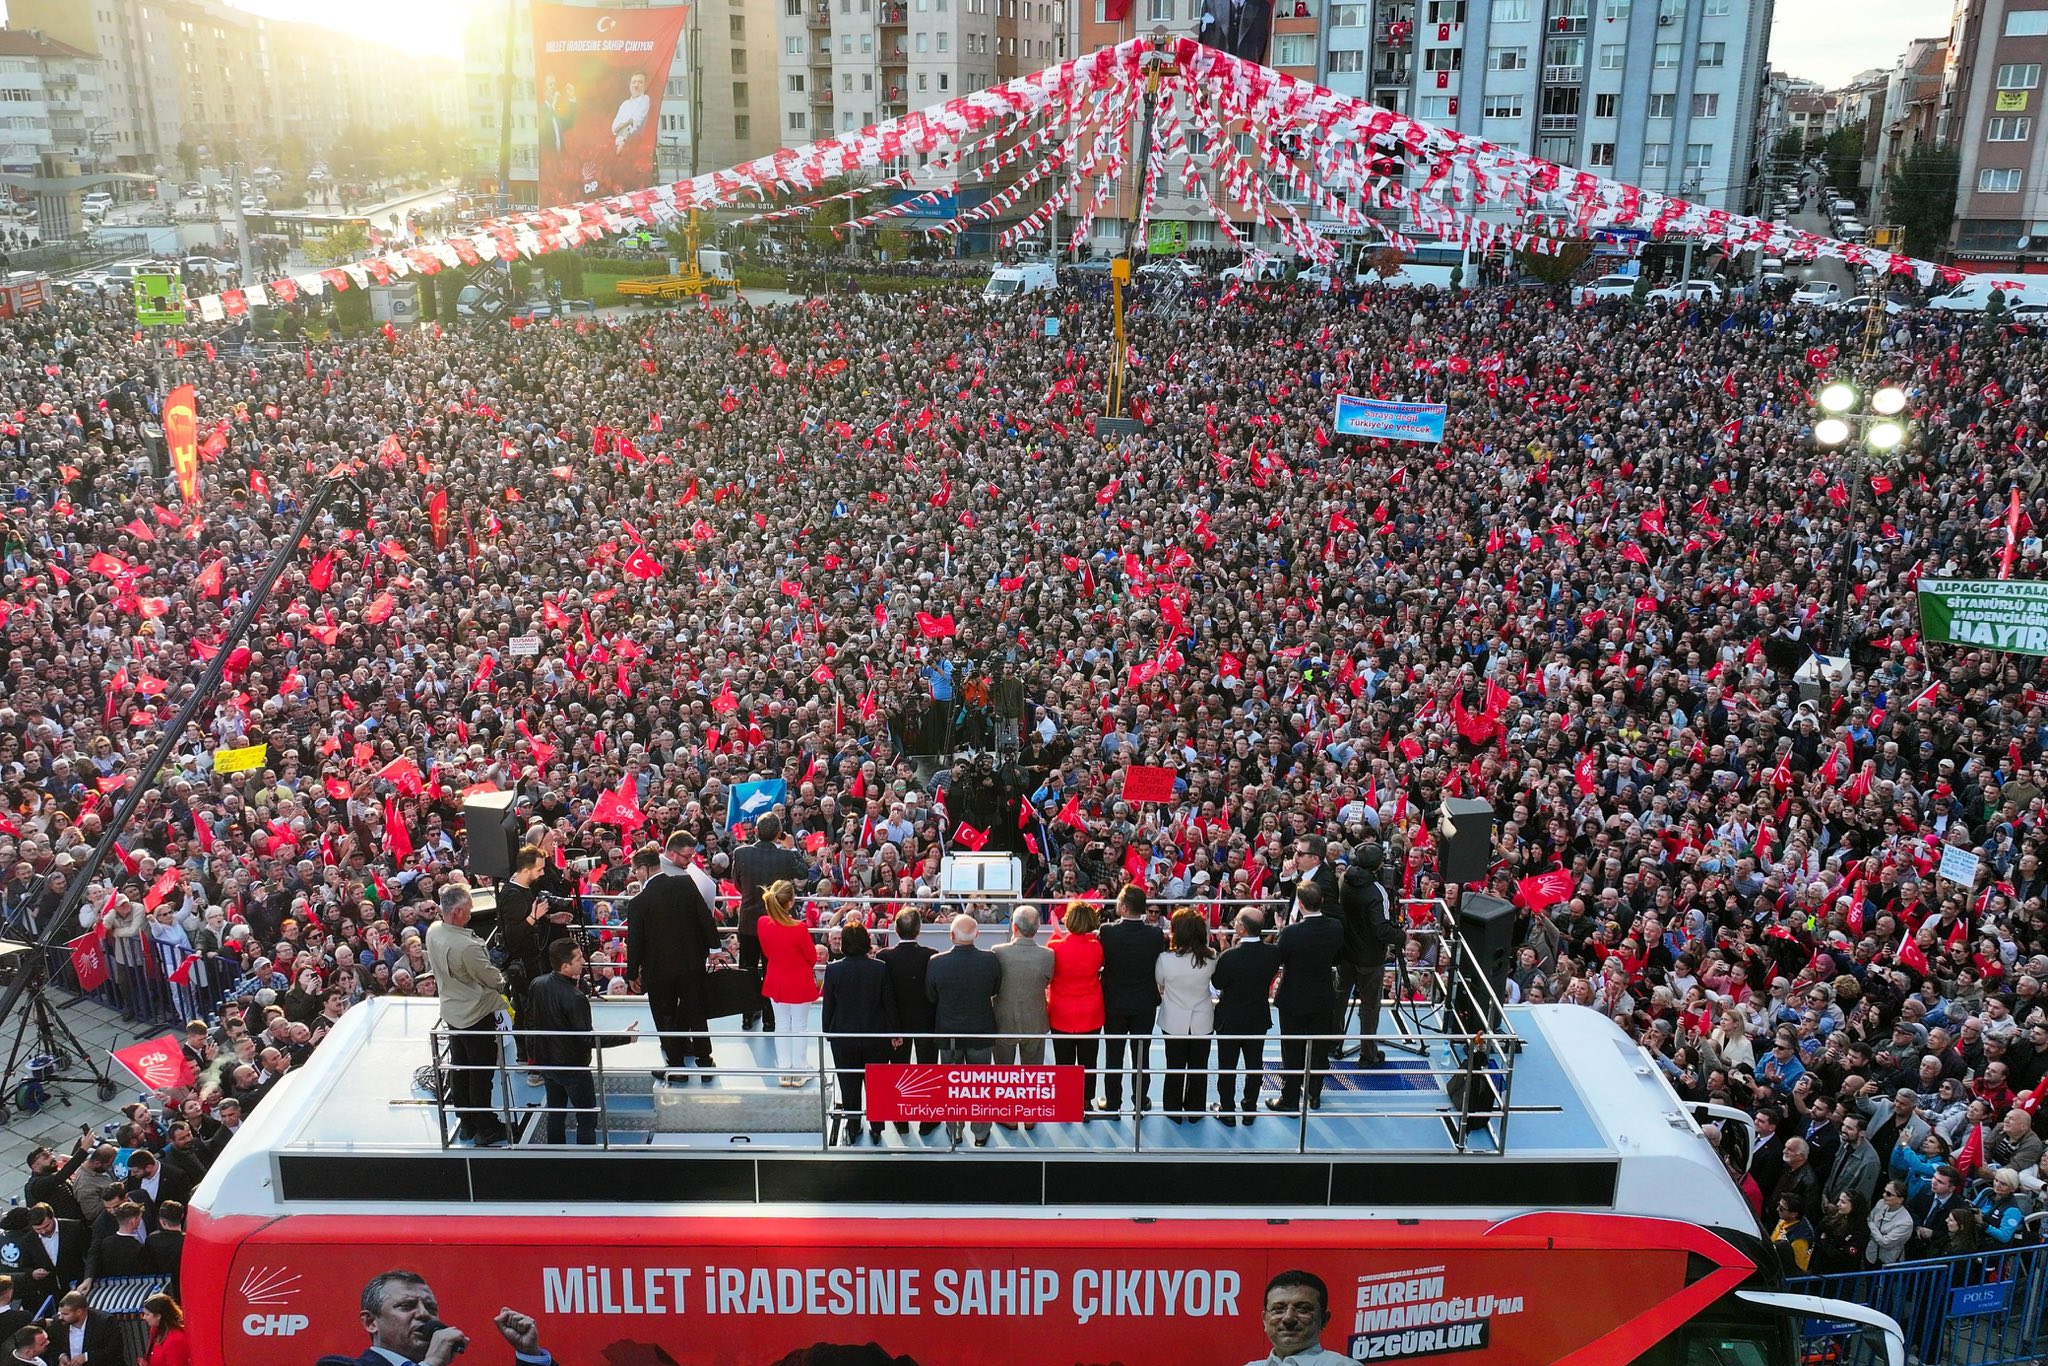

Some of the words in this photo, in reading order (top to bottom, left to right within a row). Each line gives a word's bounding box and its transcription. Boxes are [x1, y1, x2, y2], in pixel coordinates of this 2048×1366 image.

[602, 40, 624, 51] SAHİP
[625, 41, 654, 53] ÇIKIYOR
[584, 180, 598, 193] CHP
[1365, 410, 1394, 420] Saraya
[1396, 413, 1418, 422] değil
[1350, 419, 1394, 430] Türkiye'ye
[1396, 424, 1431, 433] yetecek
[1947, 596, 2026, 612] SİYANÜRLÜ
[1949, 620, 2048, 652] HAYIR
[947, 1068, 1056, 1084] CUMHURİYET
[948, 1086, 991, 1099] HALK
[994, 1084, 1056, 1099] PARTİSİ
[897, 1103, 968, 1119] Türkiye'nin
[971, 1104, 1011, 1117] Birinci
[1015, 1104, 1056, 1117] Partisi
[1414, 1265, 1445, 1275] ADAYIMIZ
[543, 1265, 691, 1314] MİLLET
[705, 1265, 921, 1316] İRADESİNE
[934, 1267, 1059, 1316] SAHİP
[1072, 1268, 1241, 1325] ÇIKIYOR
[1356, 1276, 1444, 1309] EKREM
[1963, 1290, 1994, 1303] POLİS
[1354, 1295, 1524, 1334] İMAMOĞLU'NA
[242, 1313, 309, 1336] CHP
[1352, 1323, 1484, 1360] ÖZGÜRLÜK
